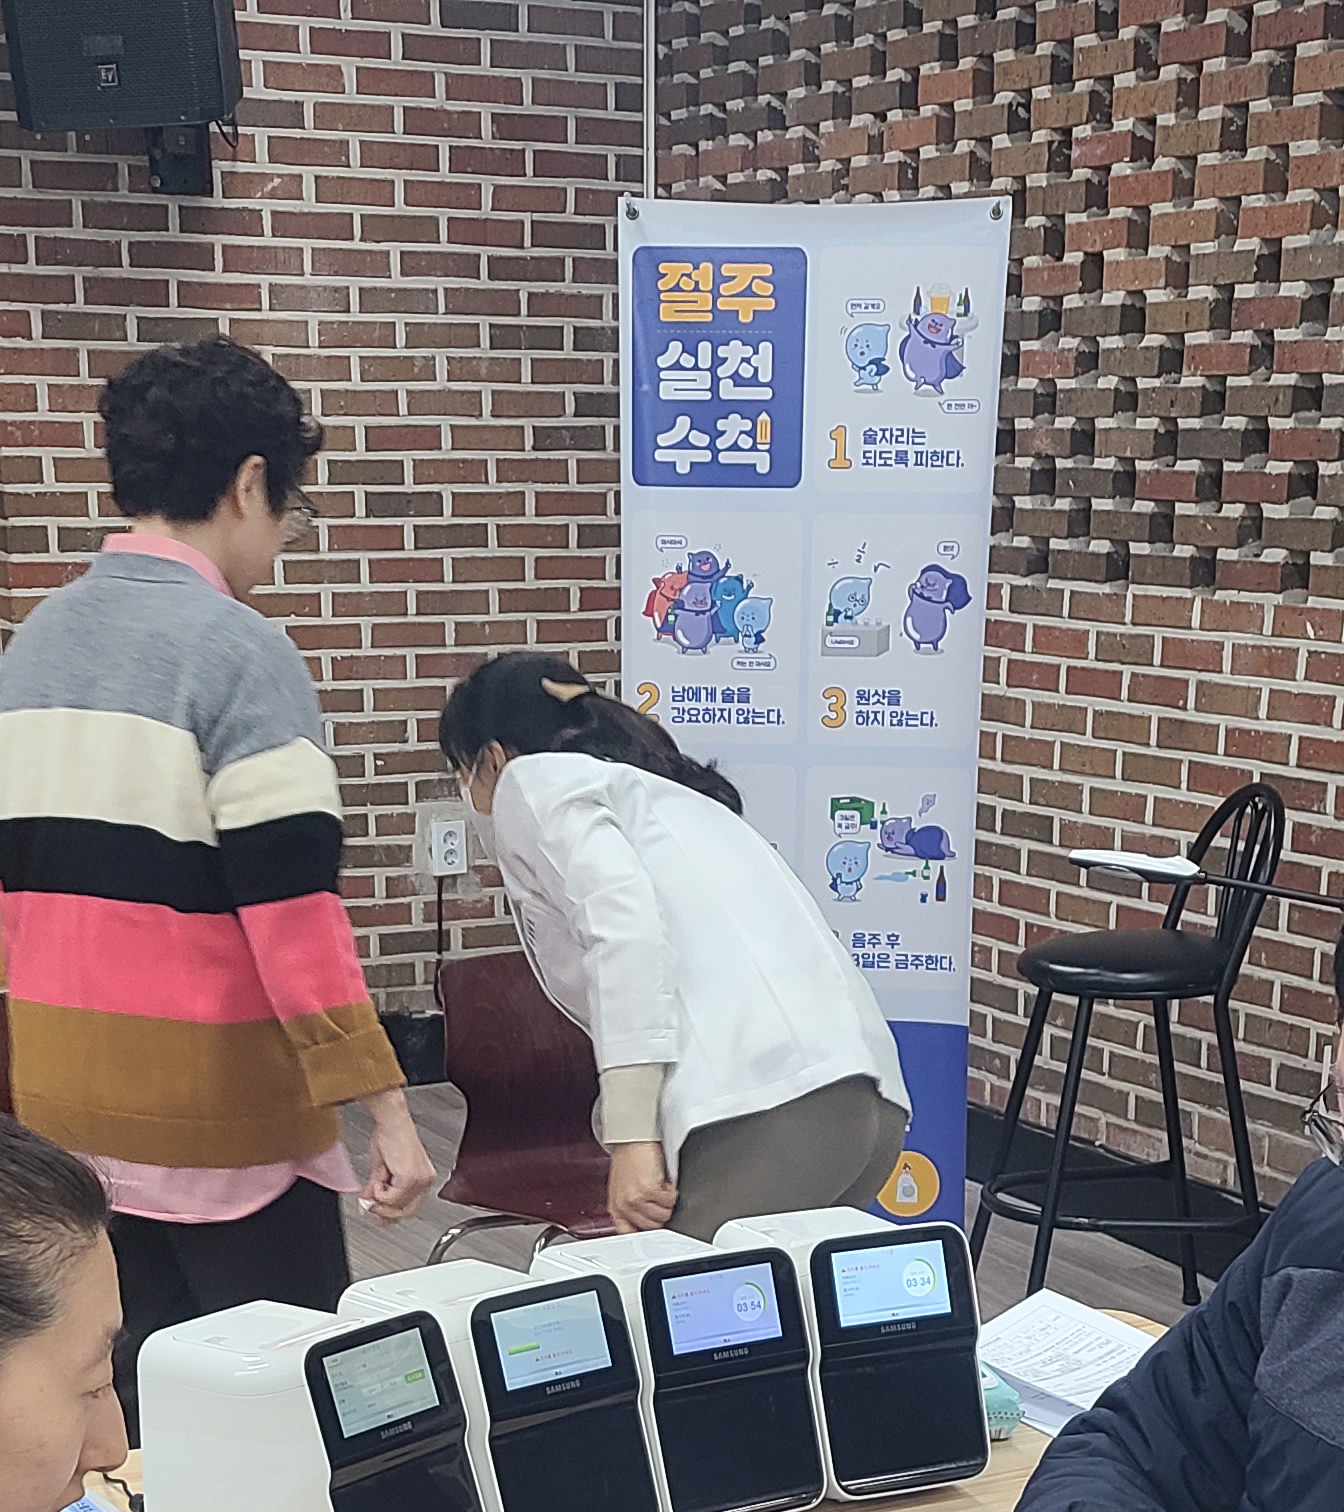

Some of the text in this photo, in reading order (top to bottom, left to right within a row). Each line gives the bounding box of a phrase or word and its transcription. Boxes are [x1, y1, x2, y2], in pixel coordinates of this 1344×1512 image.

[656, 261, 775, 323] 절주
[656, 339, 774, 401] 실천
[654, 410, 771, 475] 수칙
[862, 426, 927, 447] 술자리는
[827, 425, 853, 470] 1
[861, 449, 965, 470] 되도록 피한다.
[671, 685, 752, 704] 남에게 술을
[855, 689, 903, 707] 원샷을
[670, 707, 787, 727] 강요하지 않는다.
[821, 686, 847, 729] 3
[855, 710, 940, 729] 하지 않는다.
[851, 932, 901, 950] 음주 후
[894, 953, 957, 972] 금주한다.
[880, 1321, 917, 1334] SAMSUNG
[713, 1347, 749, 1360] SAMSUNG
[545, 1378, 581, 1395] SAMSUNG
[380, 1420, 413, 1439] SAMSUNG
